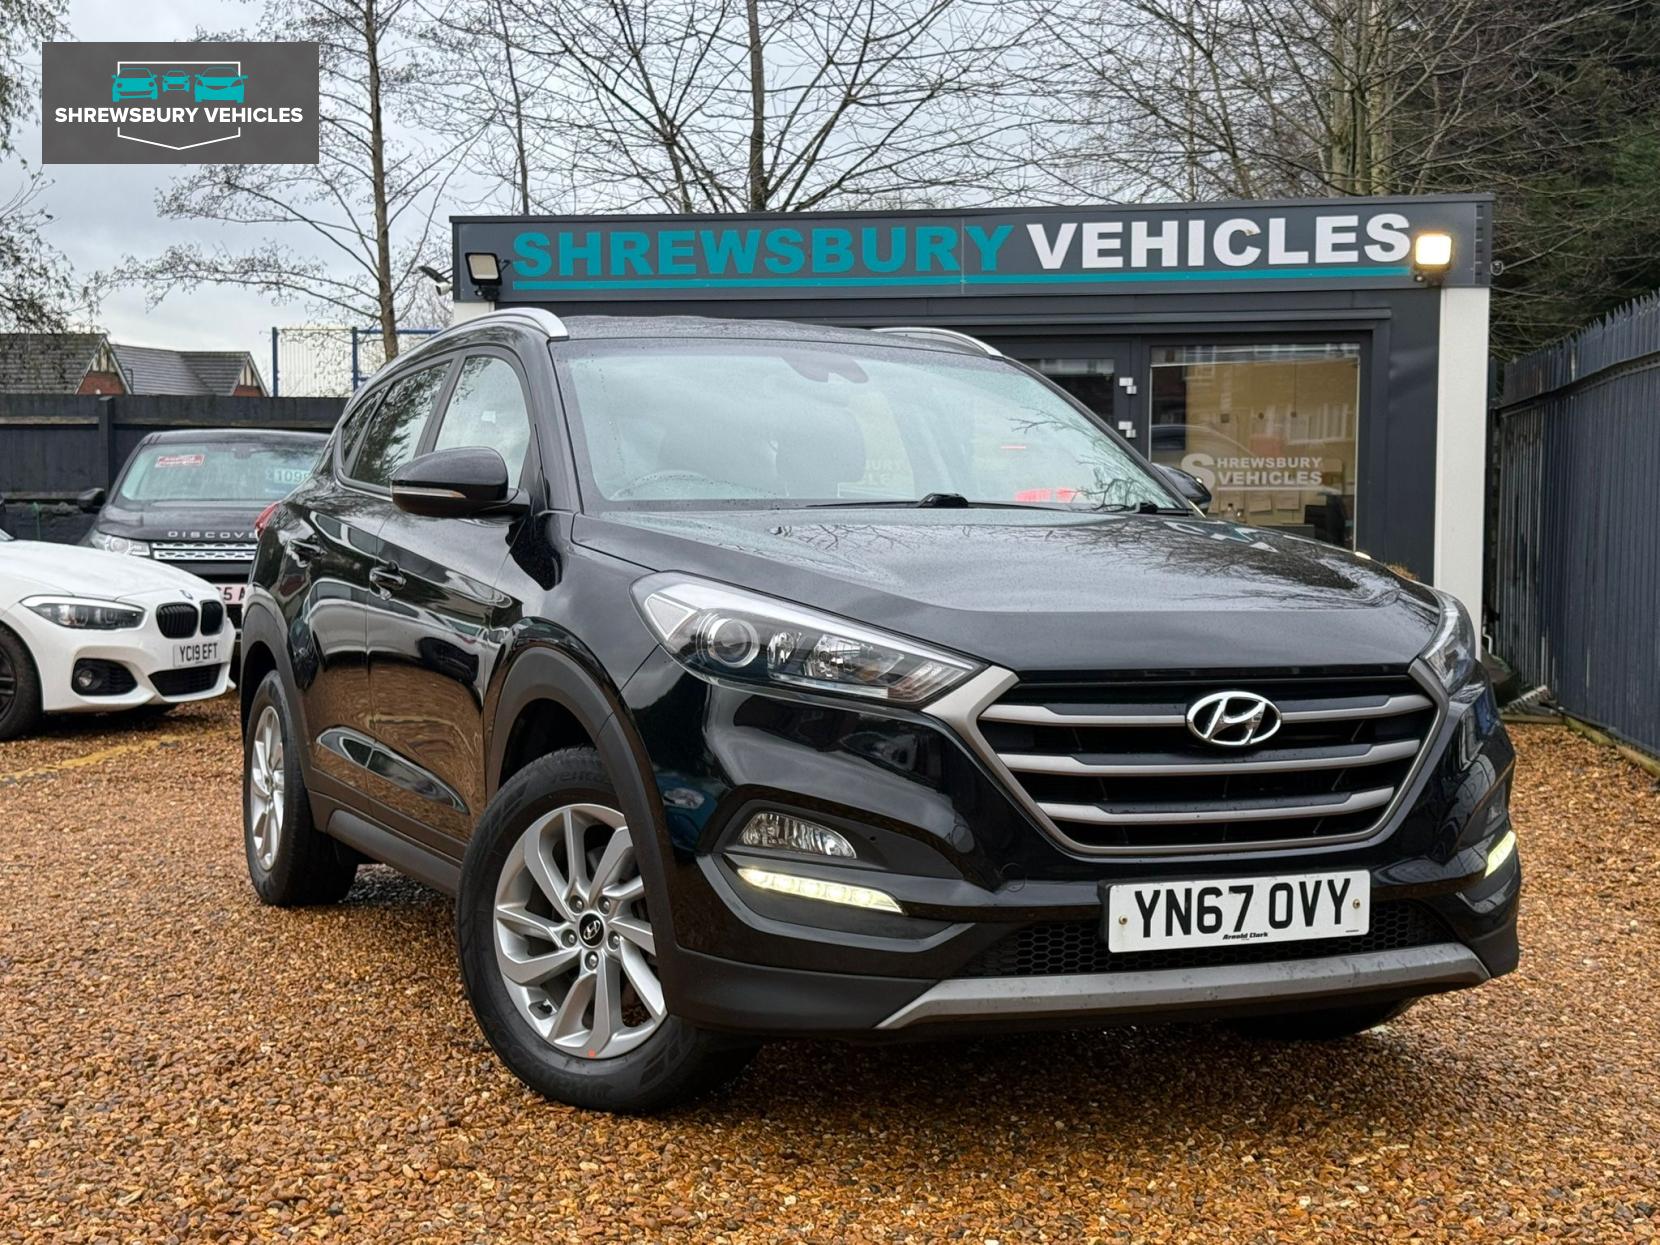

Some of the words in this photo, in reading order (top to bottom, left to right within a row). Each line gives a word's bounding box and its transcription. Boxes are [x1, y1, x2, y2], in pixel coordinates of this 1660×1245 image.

[513, 224, 1014, 277] SHREWSBURY
[1026, 213, 1411, 270] VEHICLES
[1218, 471, 1322, 485] VEHICLES
[180, 644, 201, 662] YC19
[202, 643, 218, 660] EFT
[1134, 884, 1254, 938] YN67
[1268, 878, 1351, 929] OVY
